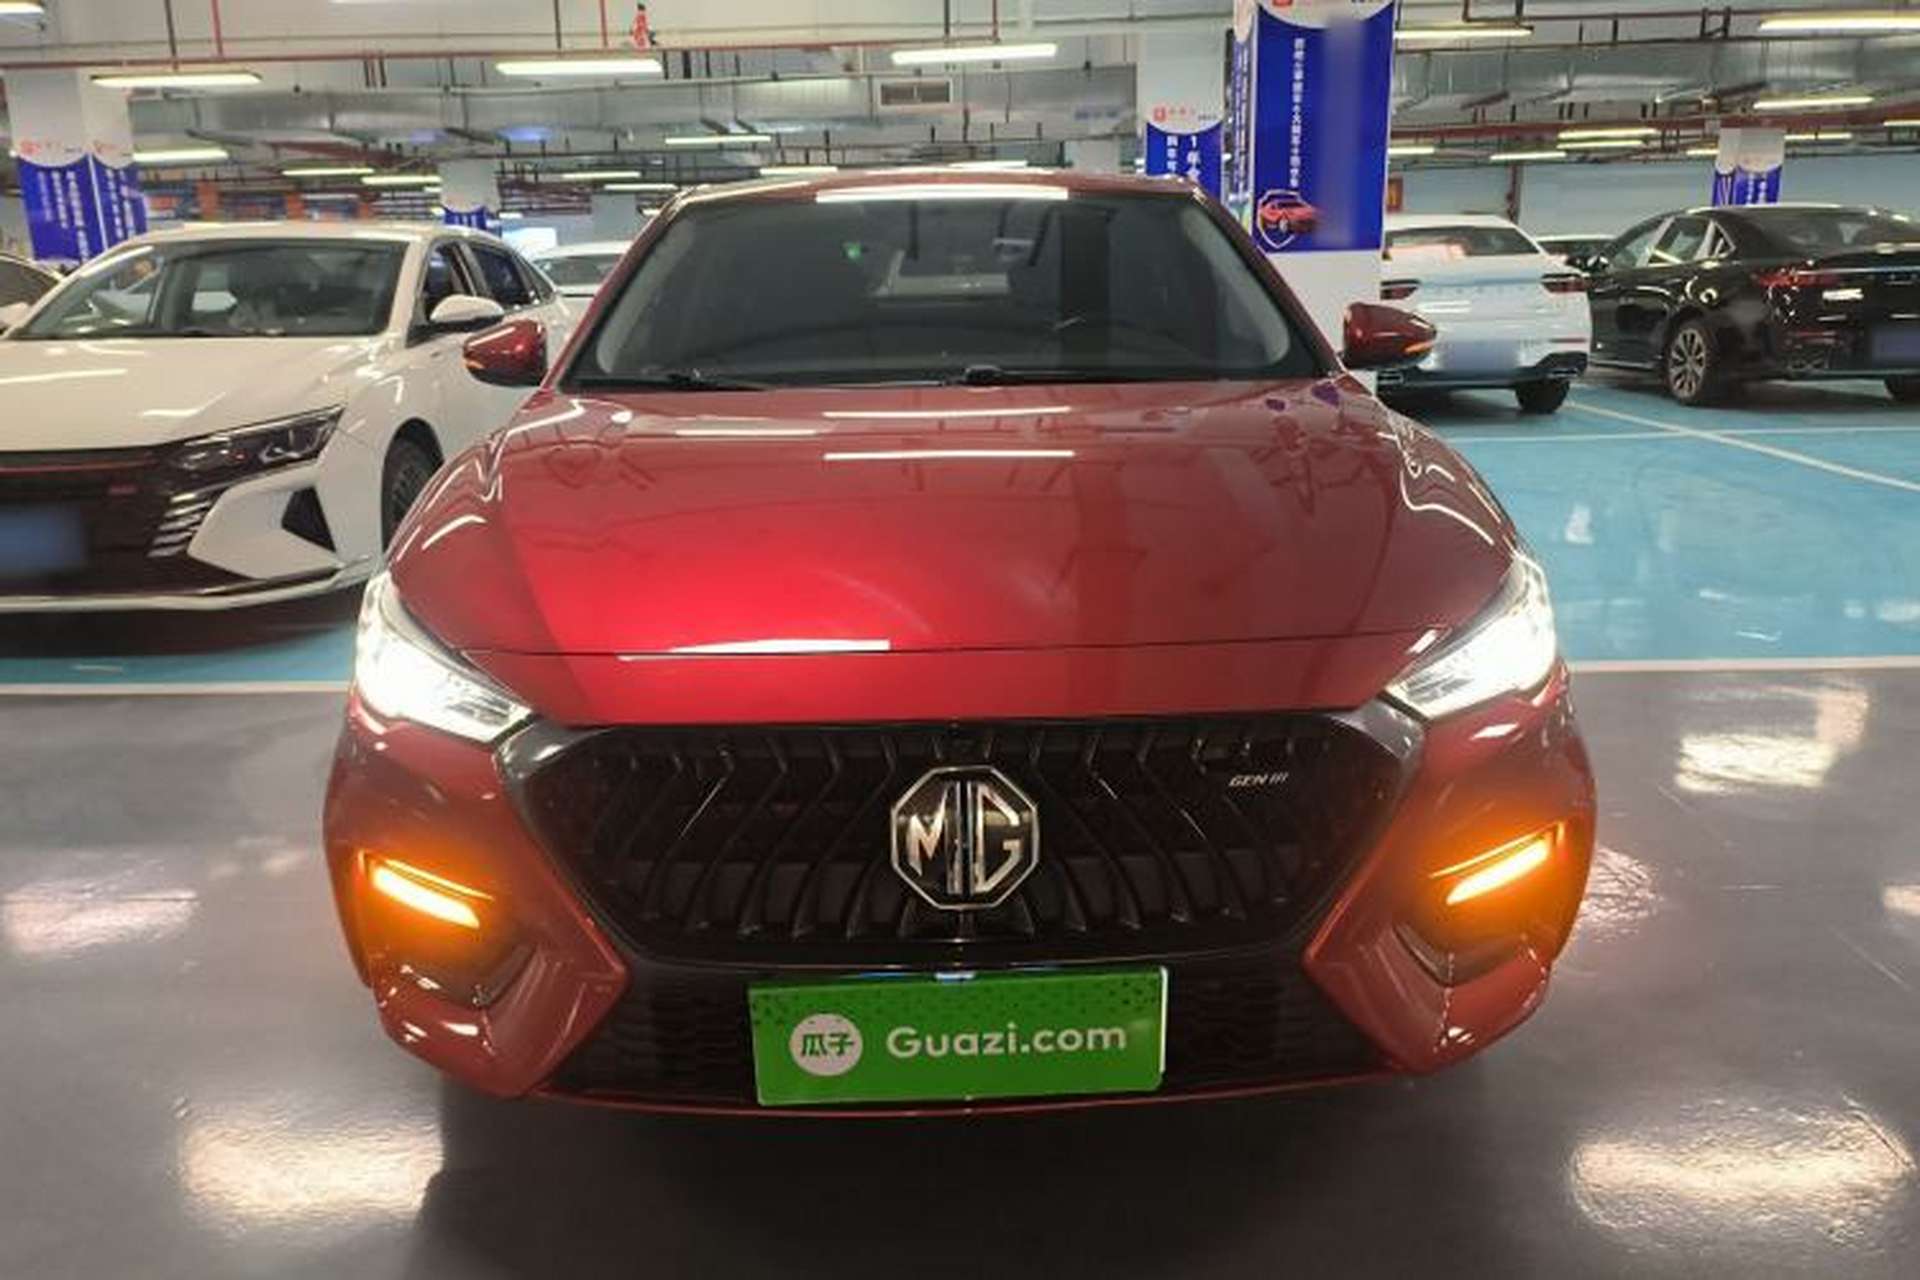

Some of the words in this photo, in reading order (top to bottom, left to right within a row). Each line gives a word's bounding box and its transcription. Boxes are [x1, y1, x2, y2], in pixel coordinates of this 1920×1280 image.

[1228, 773, 1269, 787] GEN
[906, 780, 1022, 895] MG
[801, 1032, 856, 1058] 瓜子
[886, 1021, 1127, 1059] Guazi.com
